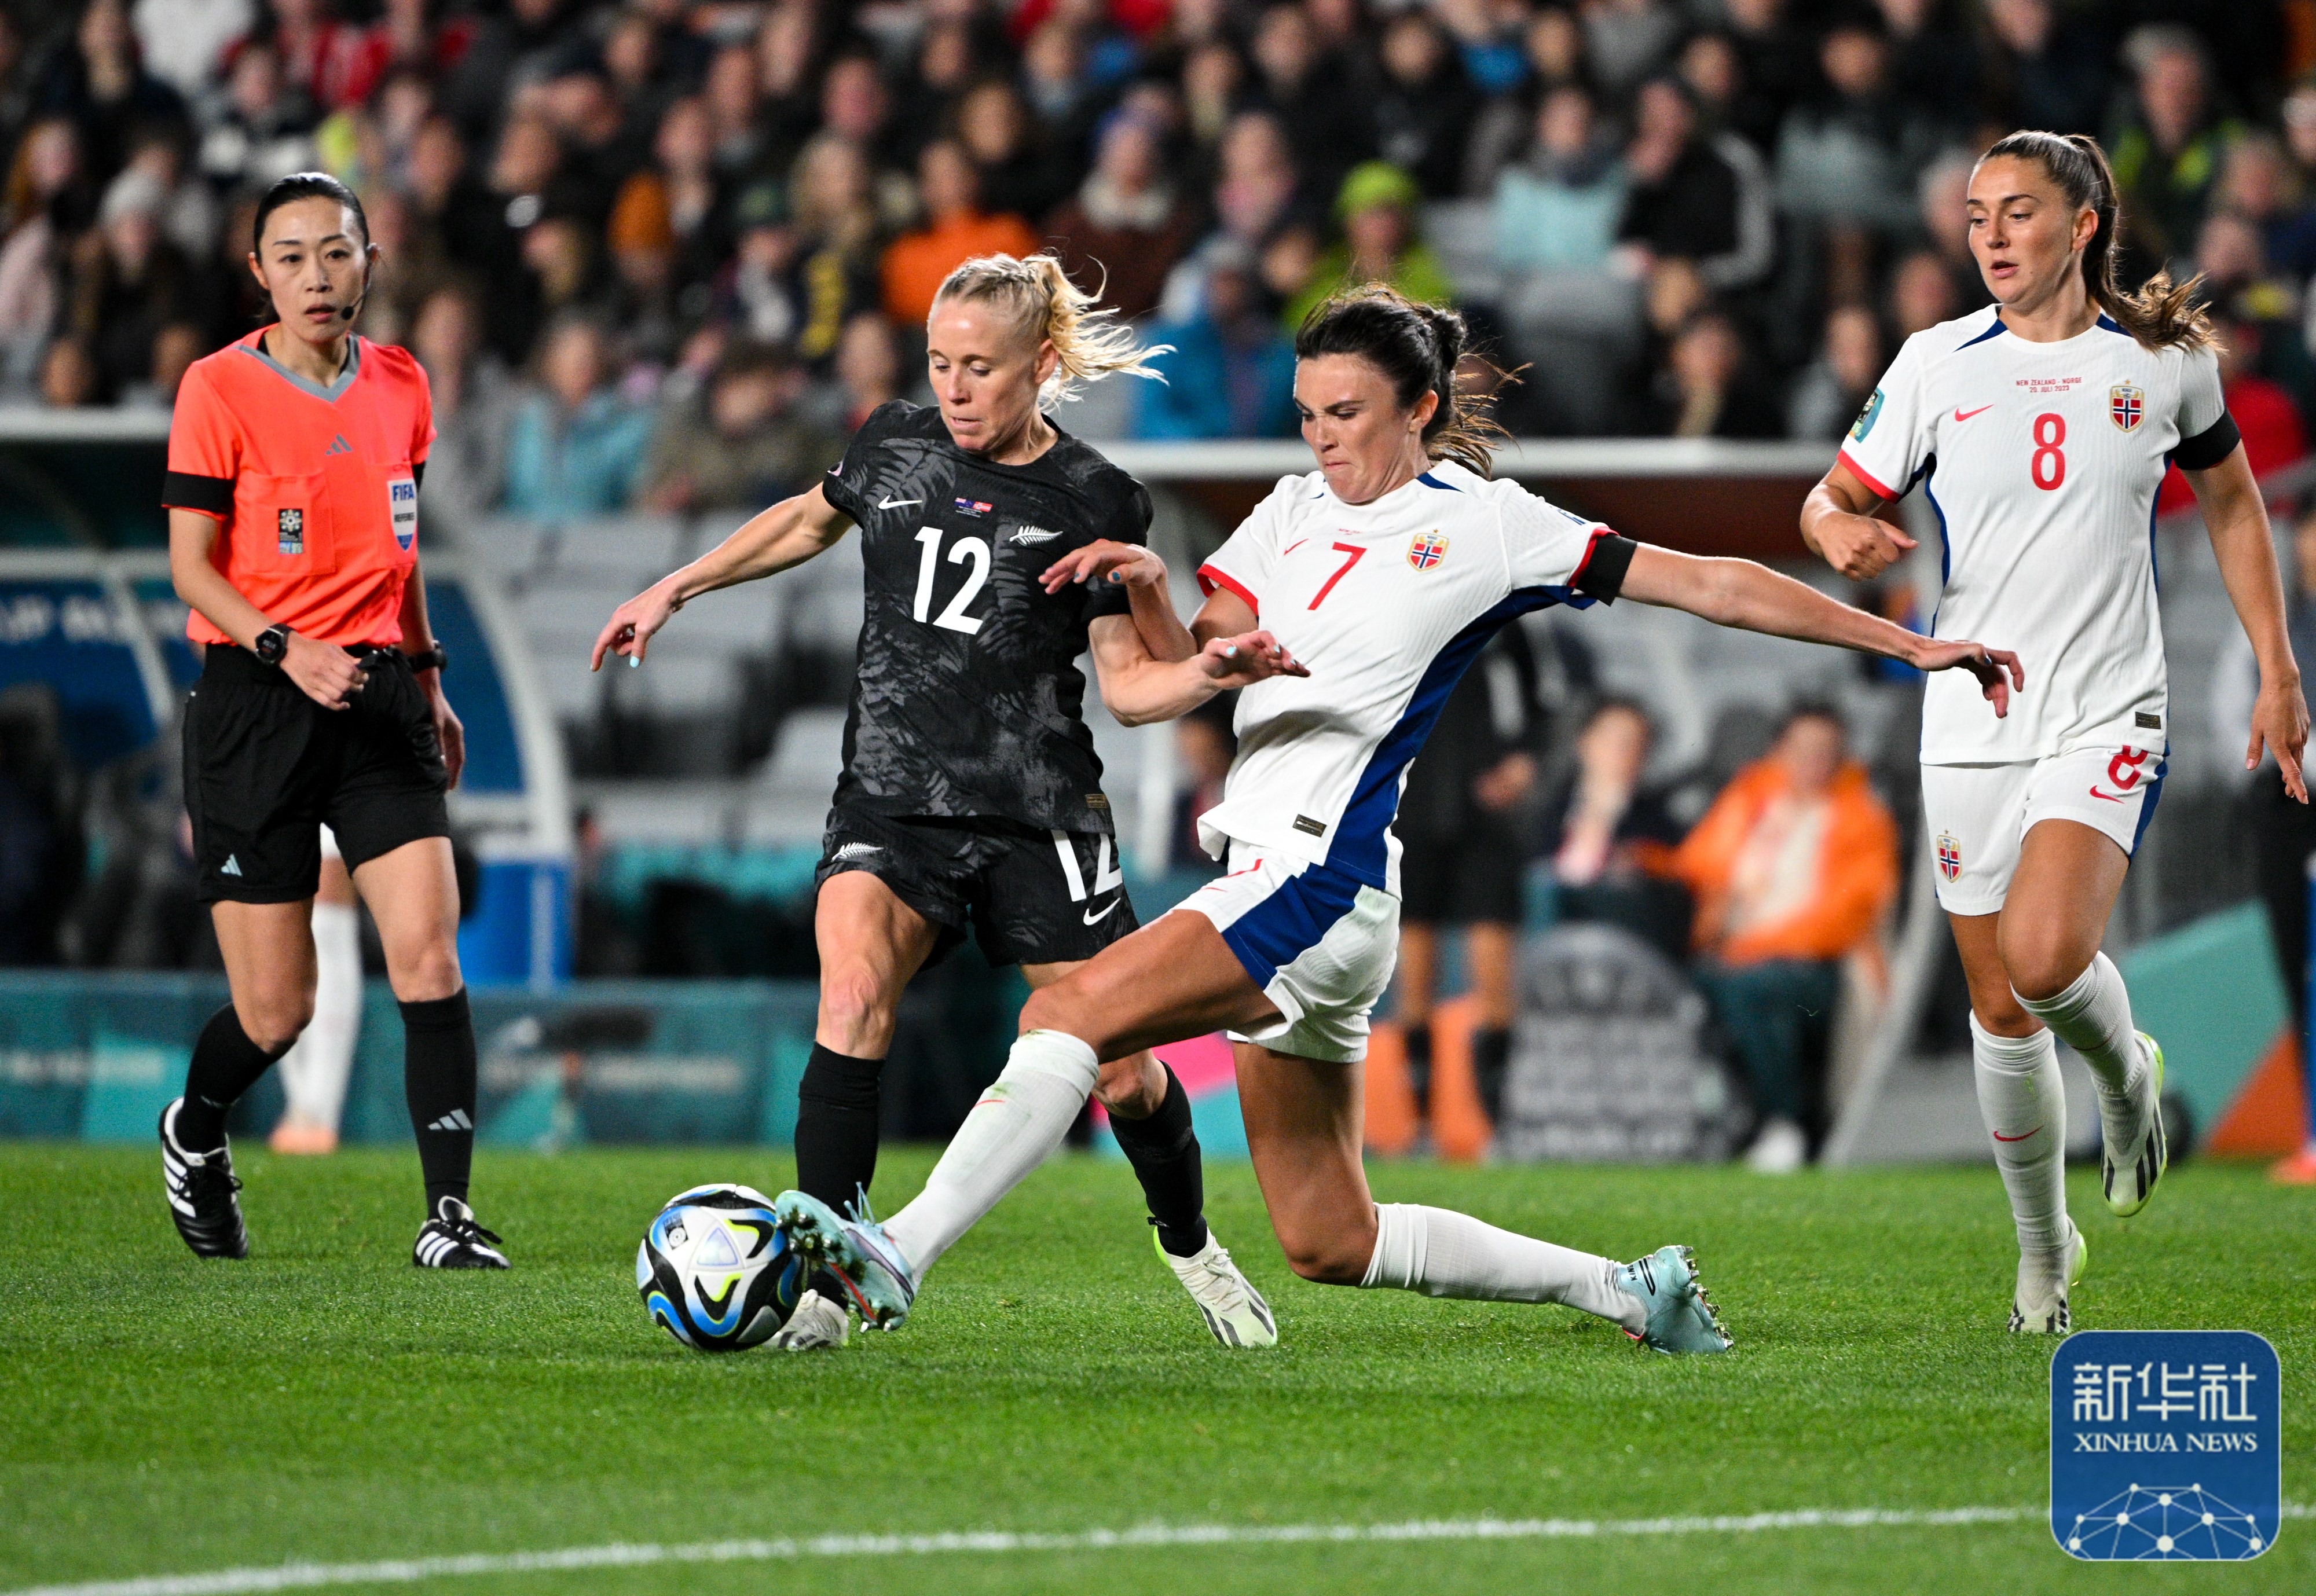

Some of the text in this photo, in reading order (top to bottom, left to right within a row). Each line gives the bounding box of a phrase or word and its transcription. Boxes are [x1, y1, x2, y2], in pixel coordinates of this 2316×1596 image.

[2031, 413, 2066, 491] 8
[392, 483, 415, 501] FIFA
[914, 526, 991, 635] 12
[1307, 541, 1368, 611] 7
